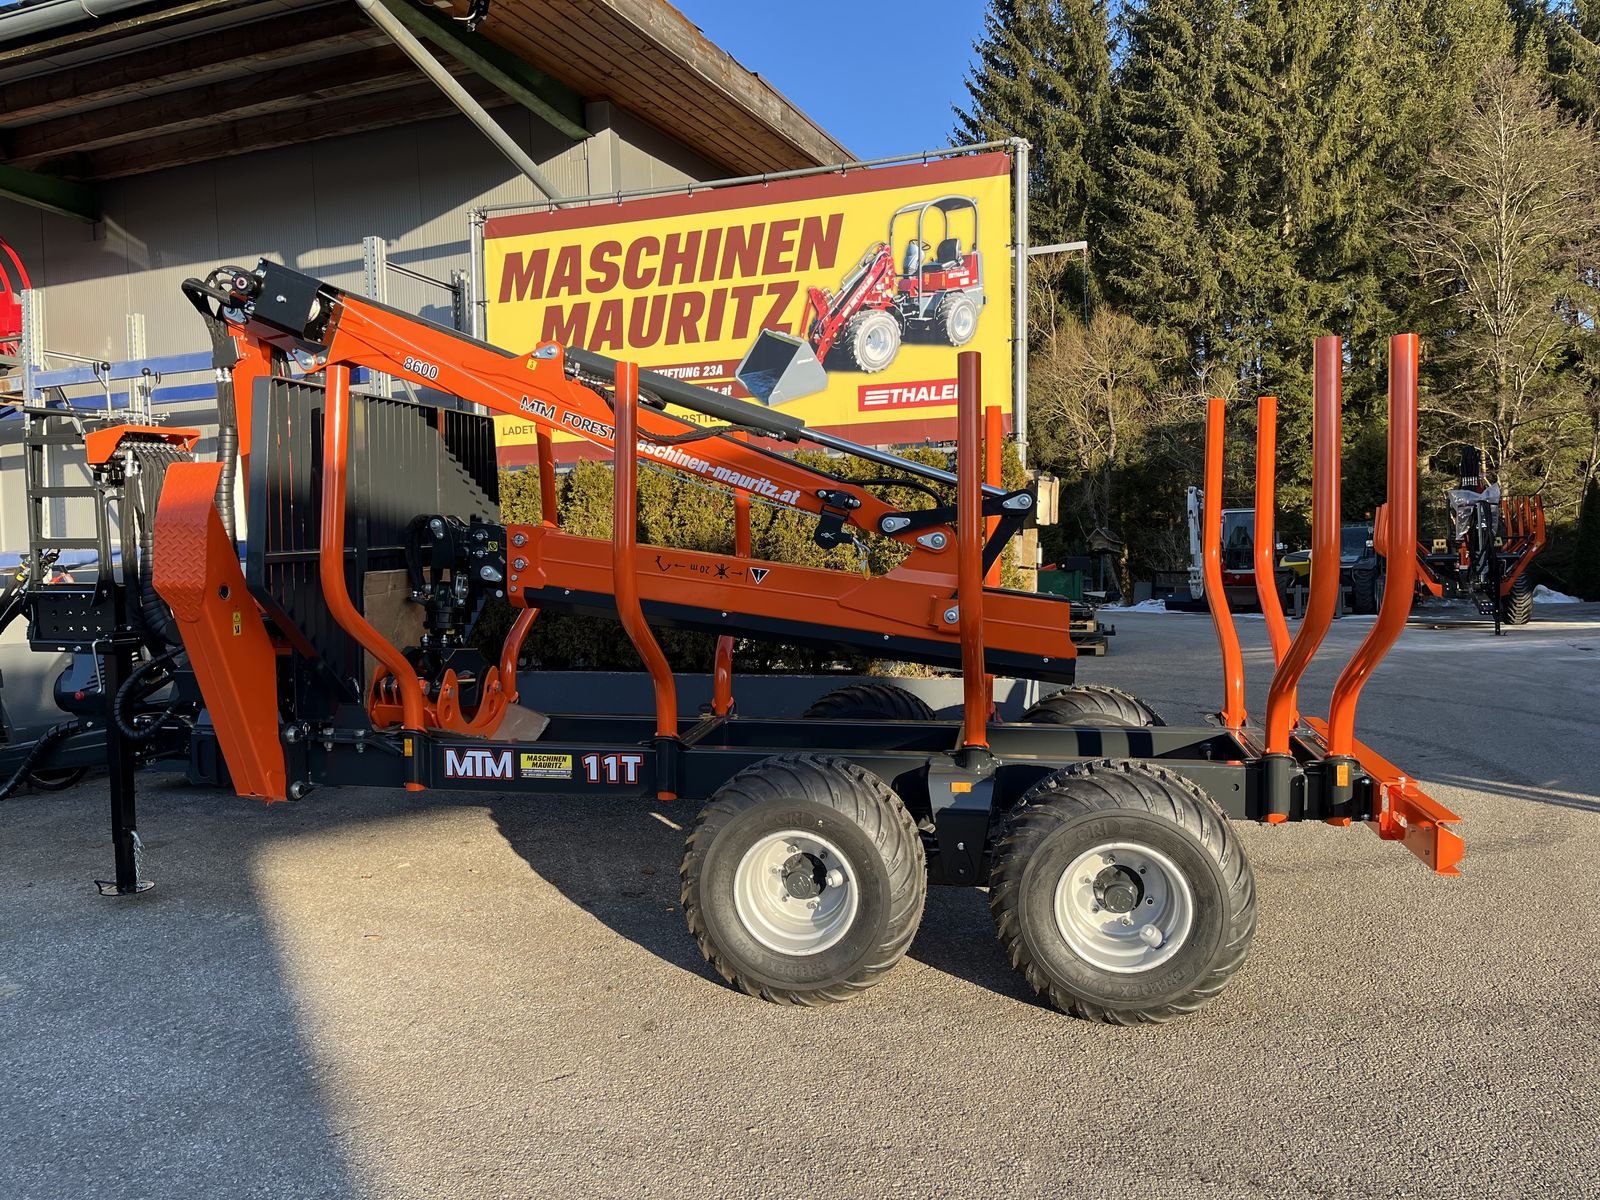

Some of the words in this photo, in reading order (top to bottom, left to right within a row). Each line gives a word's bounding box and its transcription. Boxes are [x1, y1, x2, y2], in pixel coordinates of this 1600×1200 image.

[498, 212, 845, 304] MASCHINEN
[539, 279, 800, 353] MAURITZ
[403, 355, 439, 379] 8600
[702, 364, 724, 377] 23A
[502, 424, 536, 436] LADET
[520, 395, 557, 420] MTM
[561, 411, 616, 441] FOREST
[636, 438, 802, 506] aschinen-mauritz.at
[444, 748, 514, 780] MTM
[526, 754, 568, 763] MASCHINEN
[531, 761, 563, 769] MAURITZ
[582, 753, 643, 784] 11T
